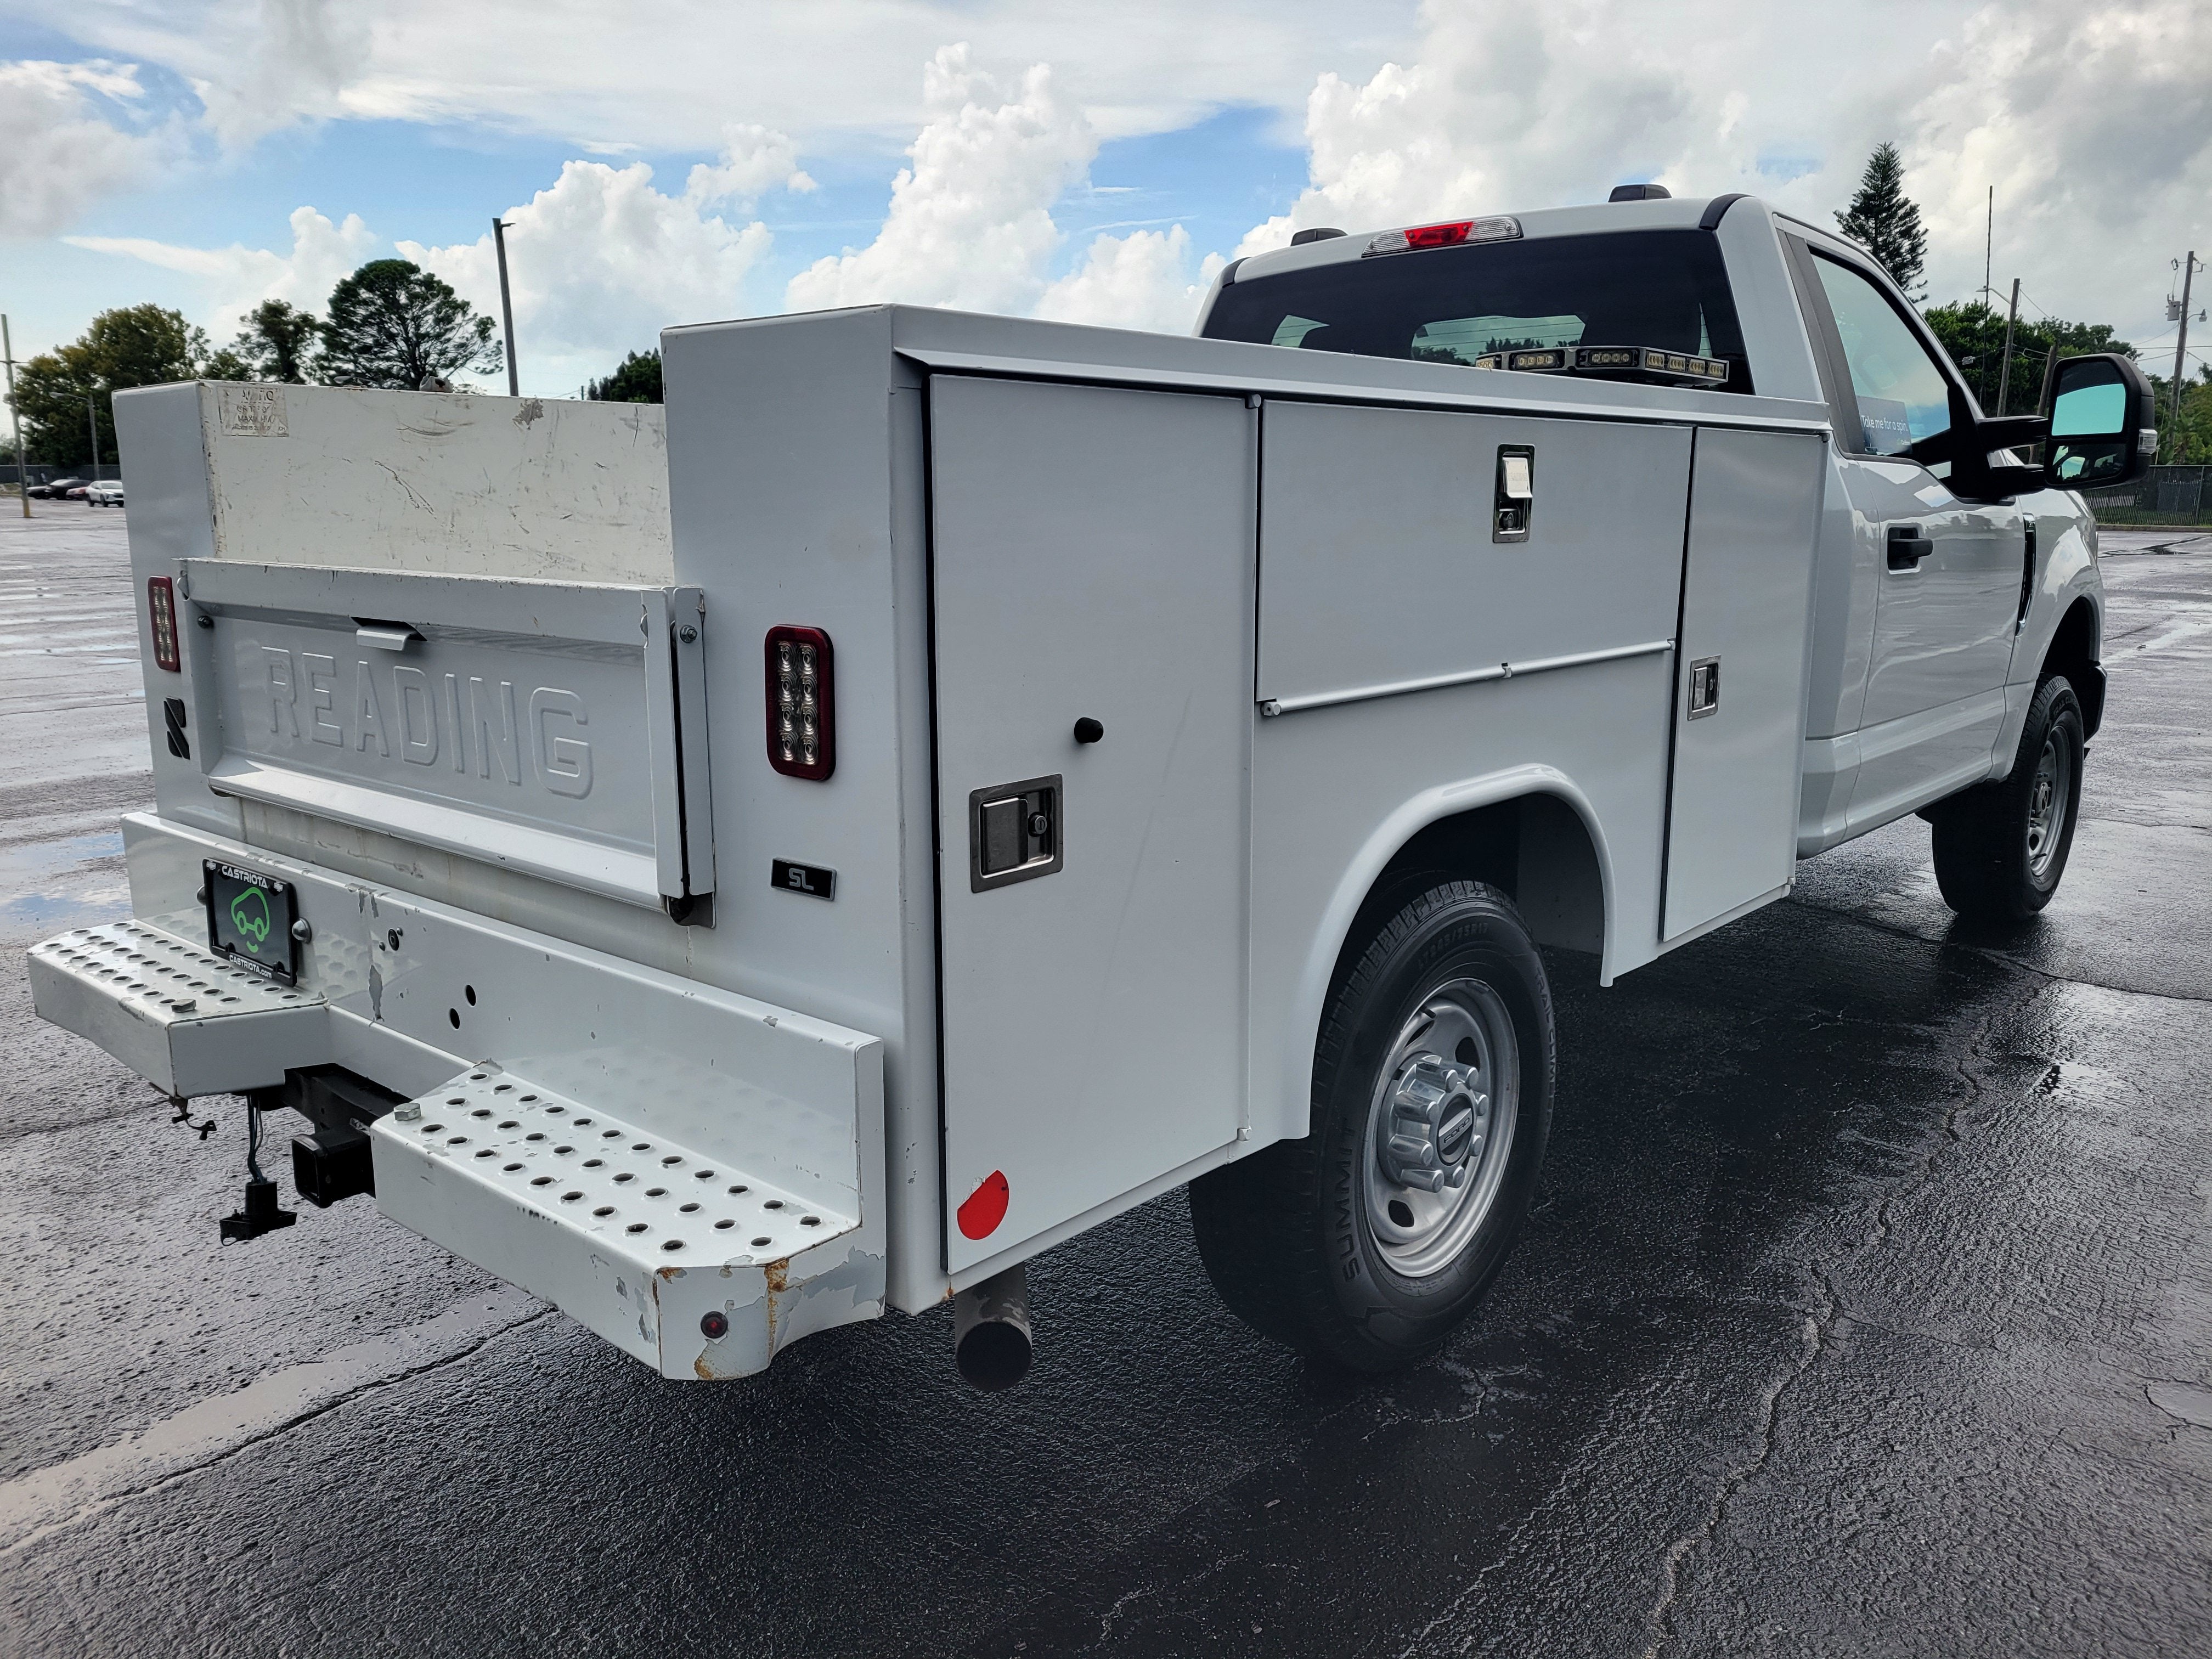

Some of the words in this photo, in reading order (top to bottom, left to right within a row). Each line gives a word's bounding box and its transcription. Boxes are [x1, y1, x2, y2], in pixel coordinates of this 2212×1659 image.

[1861, 415, 1875, 428] Take
[1875, 420, 1883, 429] me
[1892, 421, 1896, 431] a
[261, 646, 593, 799] READING
[222, 865, 268, 888] CASTRIOTA
[789, 868, 814, 890] SL
[229, 955, 272, 979] CASTRIOTA.com
[1443, 1117, 1470, 1144] FORD
[1335, 1116, 1360, 1282] SUMMIT
